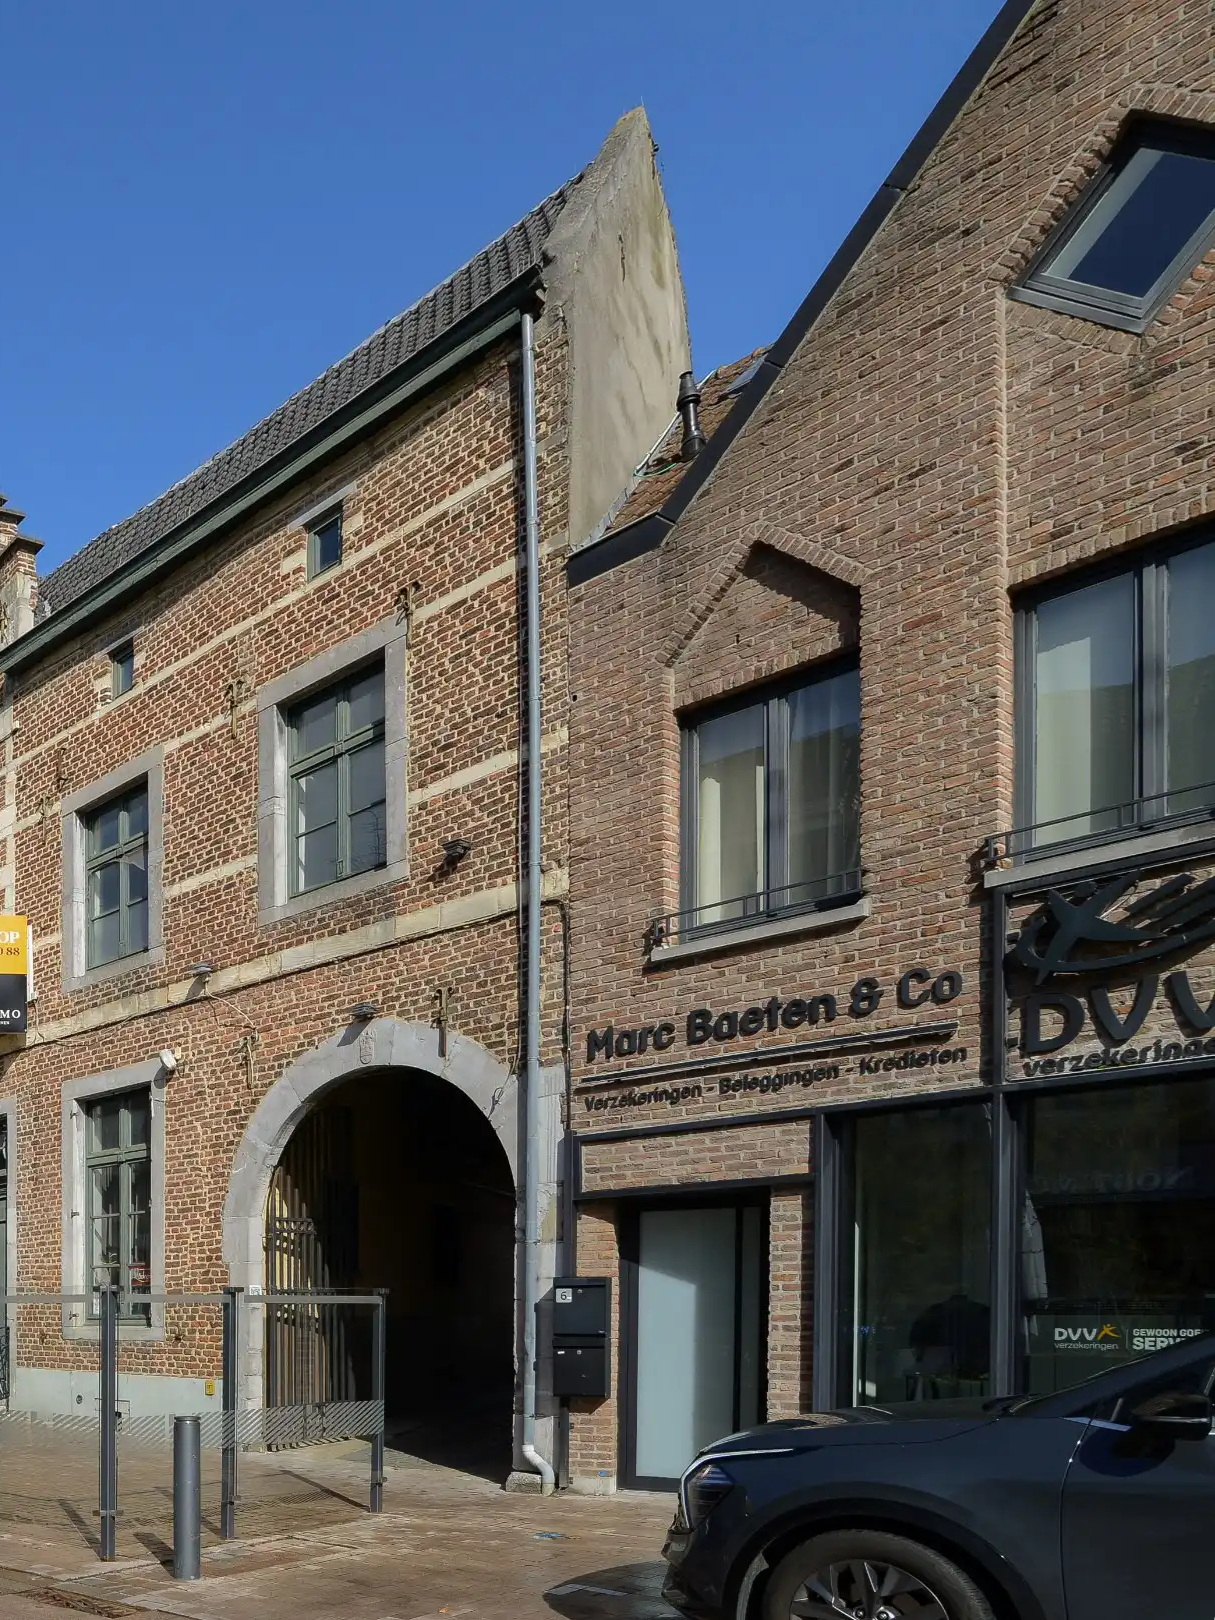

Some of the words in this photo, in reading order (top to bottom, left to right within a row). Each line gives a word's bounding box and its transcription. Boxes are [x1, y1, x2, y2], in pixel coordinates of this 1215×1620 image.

[6, 946, 20, 956] 88
[587, 1021, 676, 1064] Marc
[687, 994, 838, 1046] Baeten
[850, 977, 884, 1018] &
[897, 967, 963, 1009] Co
[1023, 970, 1215, 1053] DVV
[585, 1083, 703, 1112] Verzekeringen
[718, 1065, 840, 1095] Beleggingen
[859, 1047, 968, 1076] Kredieten
[560, 1291, 568, 1301] 6
[1054, 1328, 1097, 1341] DVV
[1132, 1329, 1177, 1337] GEWOON
[1054, 1342, 1120, 1351] verzekeringen
